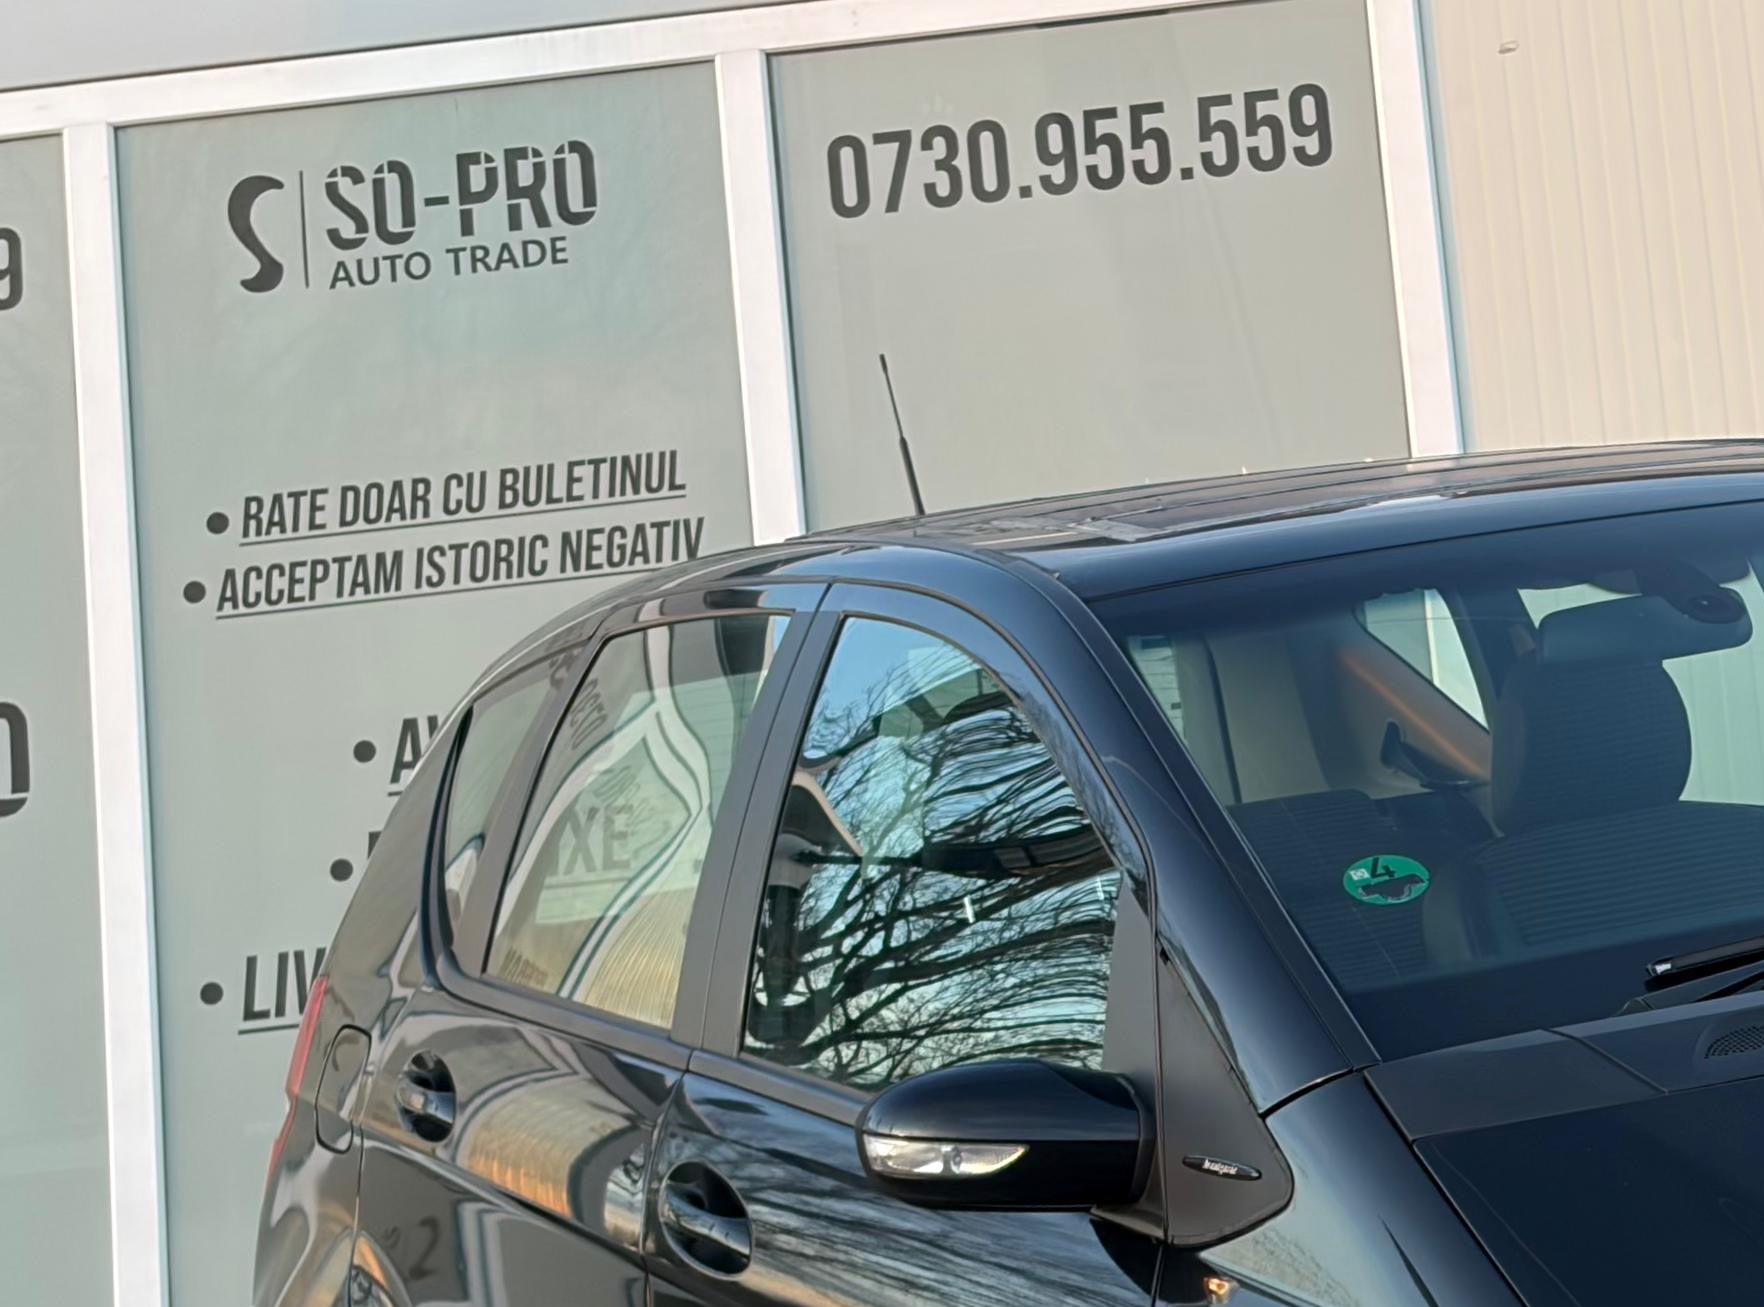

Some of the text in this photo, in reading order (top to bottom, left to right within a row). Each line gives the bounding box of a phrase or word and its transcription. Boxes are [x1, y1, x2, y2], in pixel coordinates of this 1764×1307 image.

[324, 140, 598, 251] SO-PRO
[827, 82, 1334, 219] 0730.955.559
[329, 236, 569, 289] AUTO TRADE
[242, 449, 687, 539] RATE DOAR CU BULETINUL
[217, 517, 705, 612] ACCEPTAM ISTORIC NEGATIV
